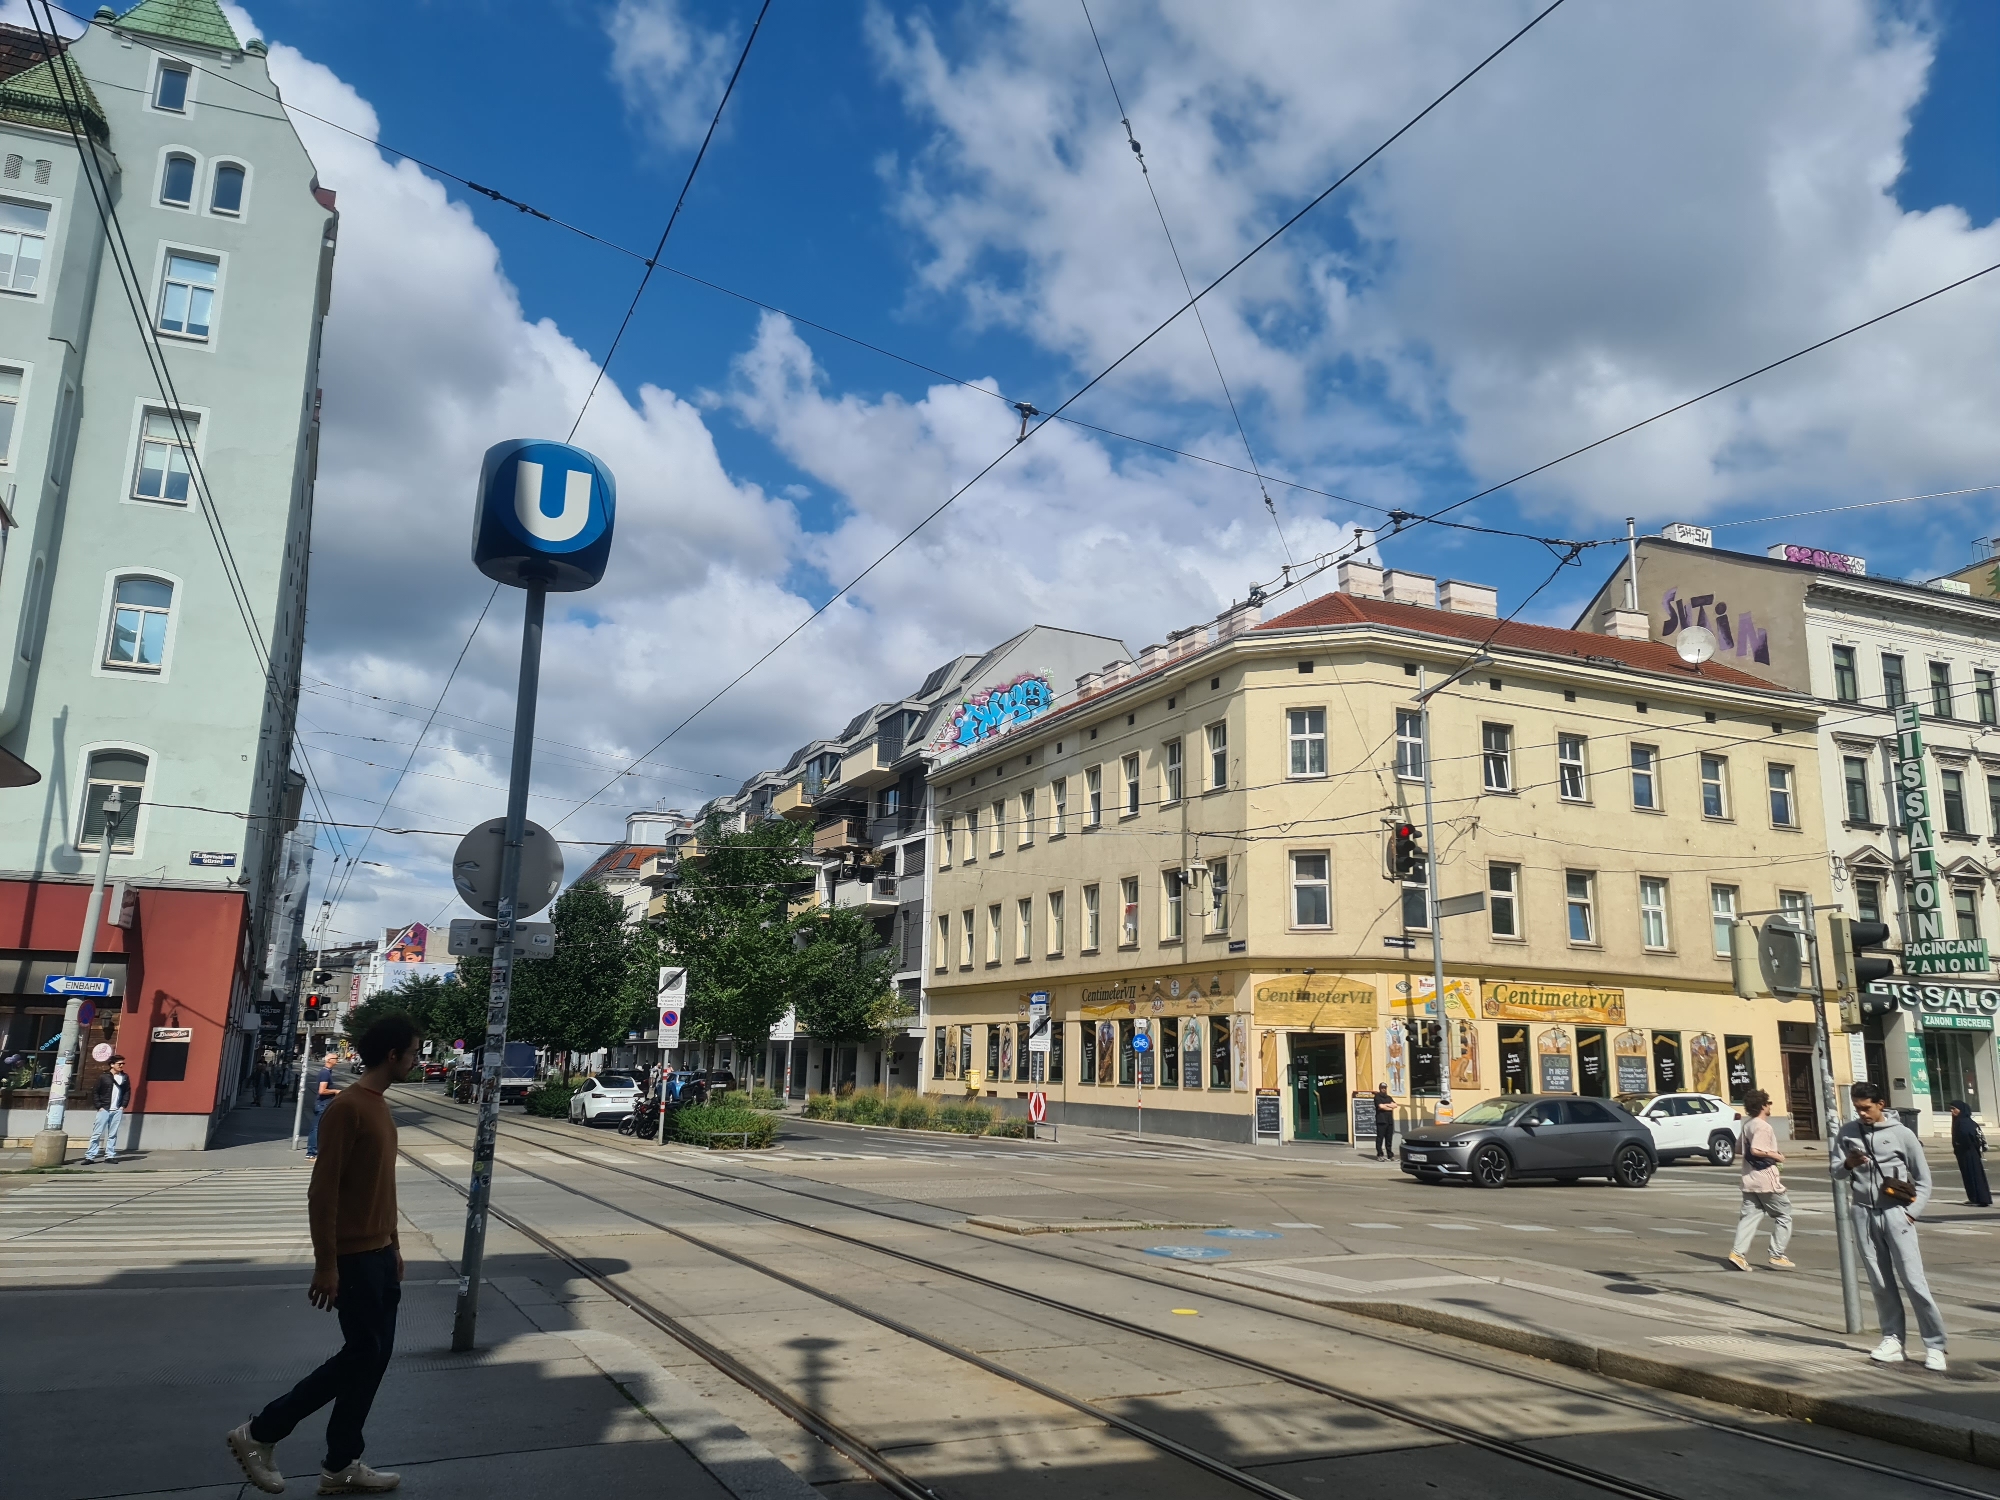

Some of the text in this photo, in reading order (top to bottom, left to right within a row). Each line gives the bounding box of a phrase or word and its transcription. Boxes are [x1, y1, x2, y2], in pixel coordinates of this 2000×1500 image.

[514, 460, 592, 542] U
[1897, 704, 1941, 941] EISSALON
[1905, 939, 1983, 957] FACINCANI
[1906, 957, 1985, 974] ZANONI
[66, 981, 102, 991] EINBAHN
[1924, 1015, 1991, 1028] ZANONI EISCREME
